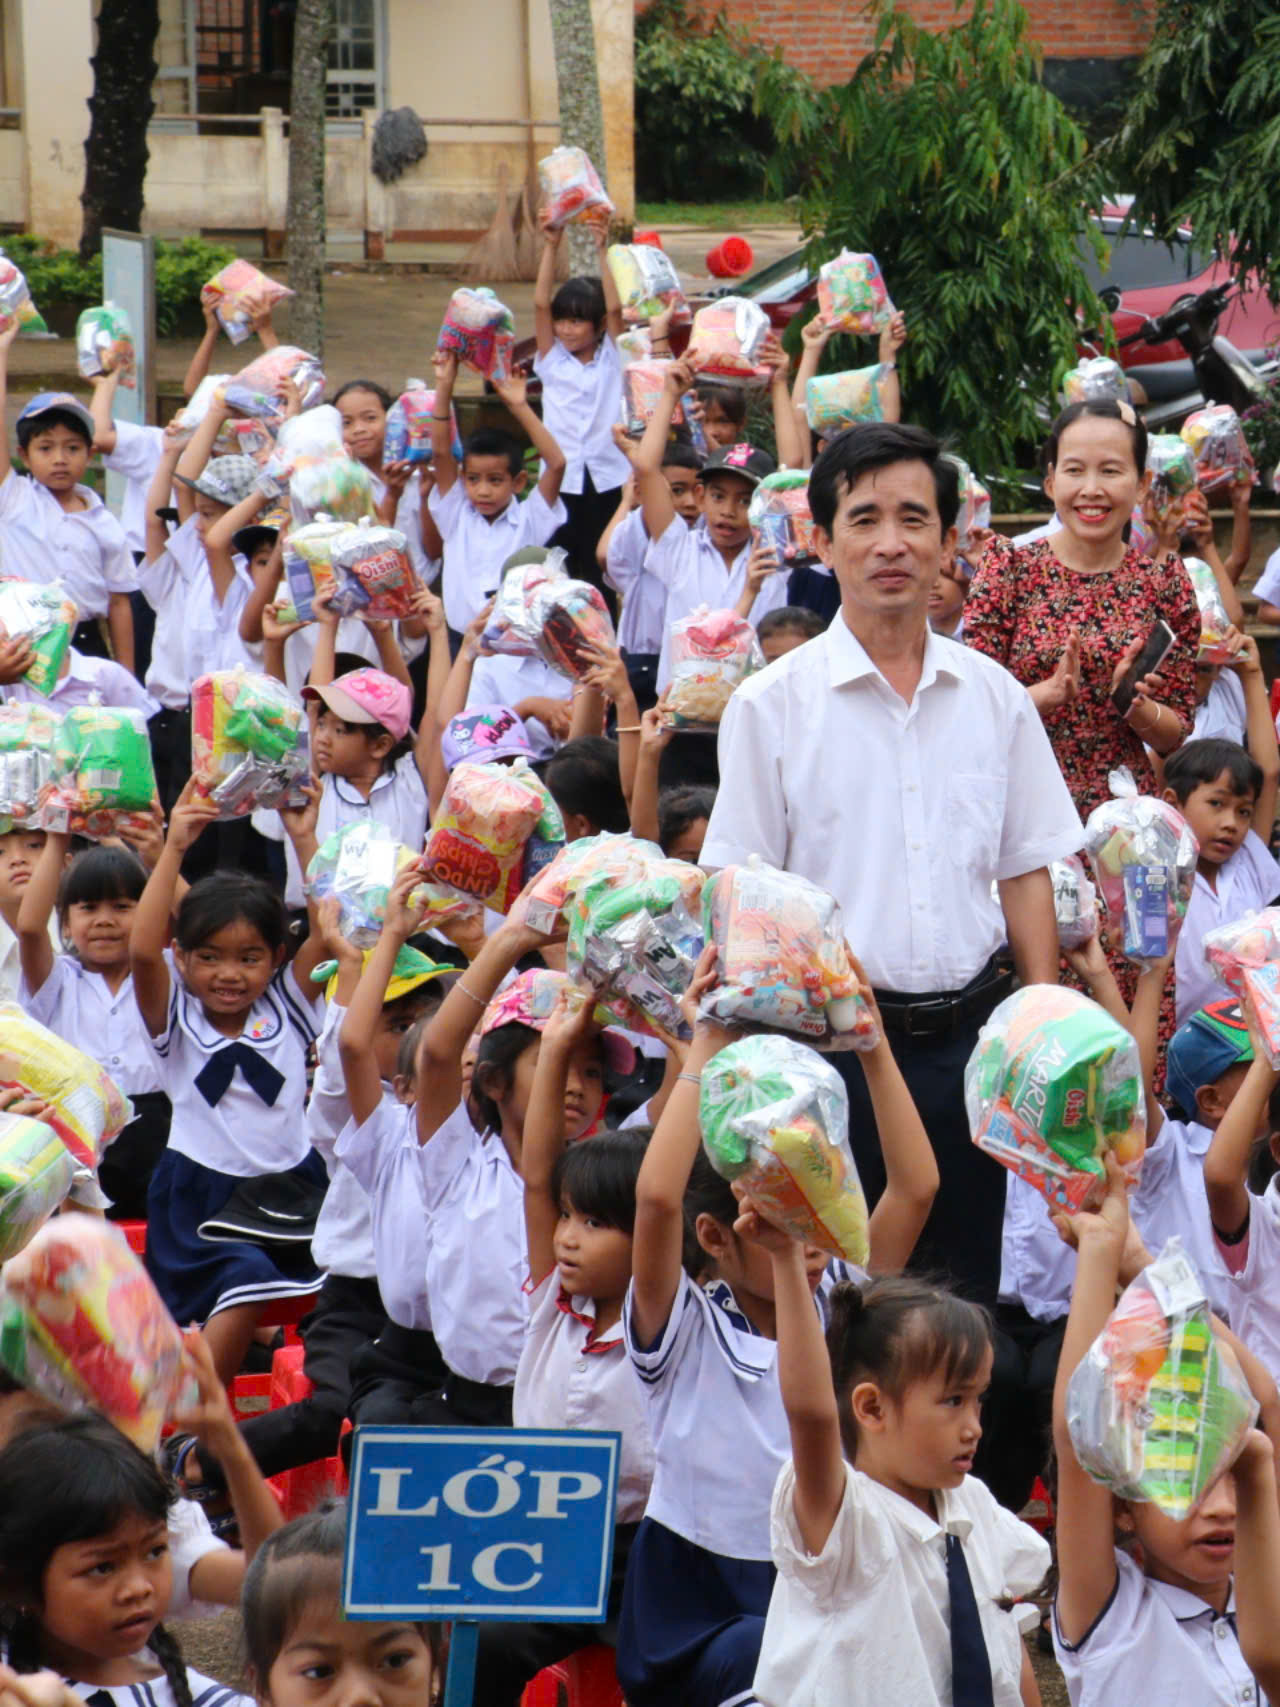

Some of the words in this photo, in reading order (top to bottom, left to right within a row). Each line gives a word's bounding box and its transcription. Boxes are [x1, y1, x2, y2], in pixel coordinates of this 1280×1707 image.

[434, 861, 492, 898] INDO
[645, 936, 678, 963] An
[1063, 1088, 1088, 1128] Oishi
[366, 1453, 603, 1519] LỚP
[416, 1542, 544, 1592] 1C
